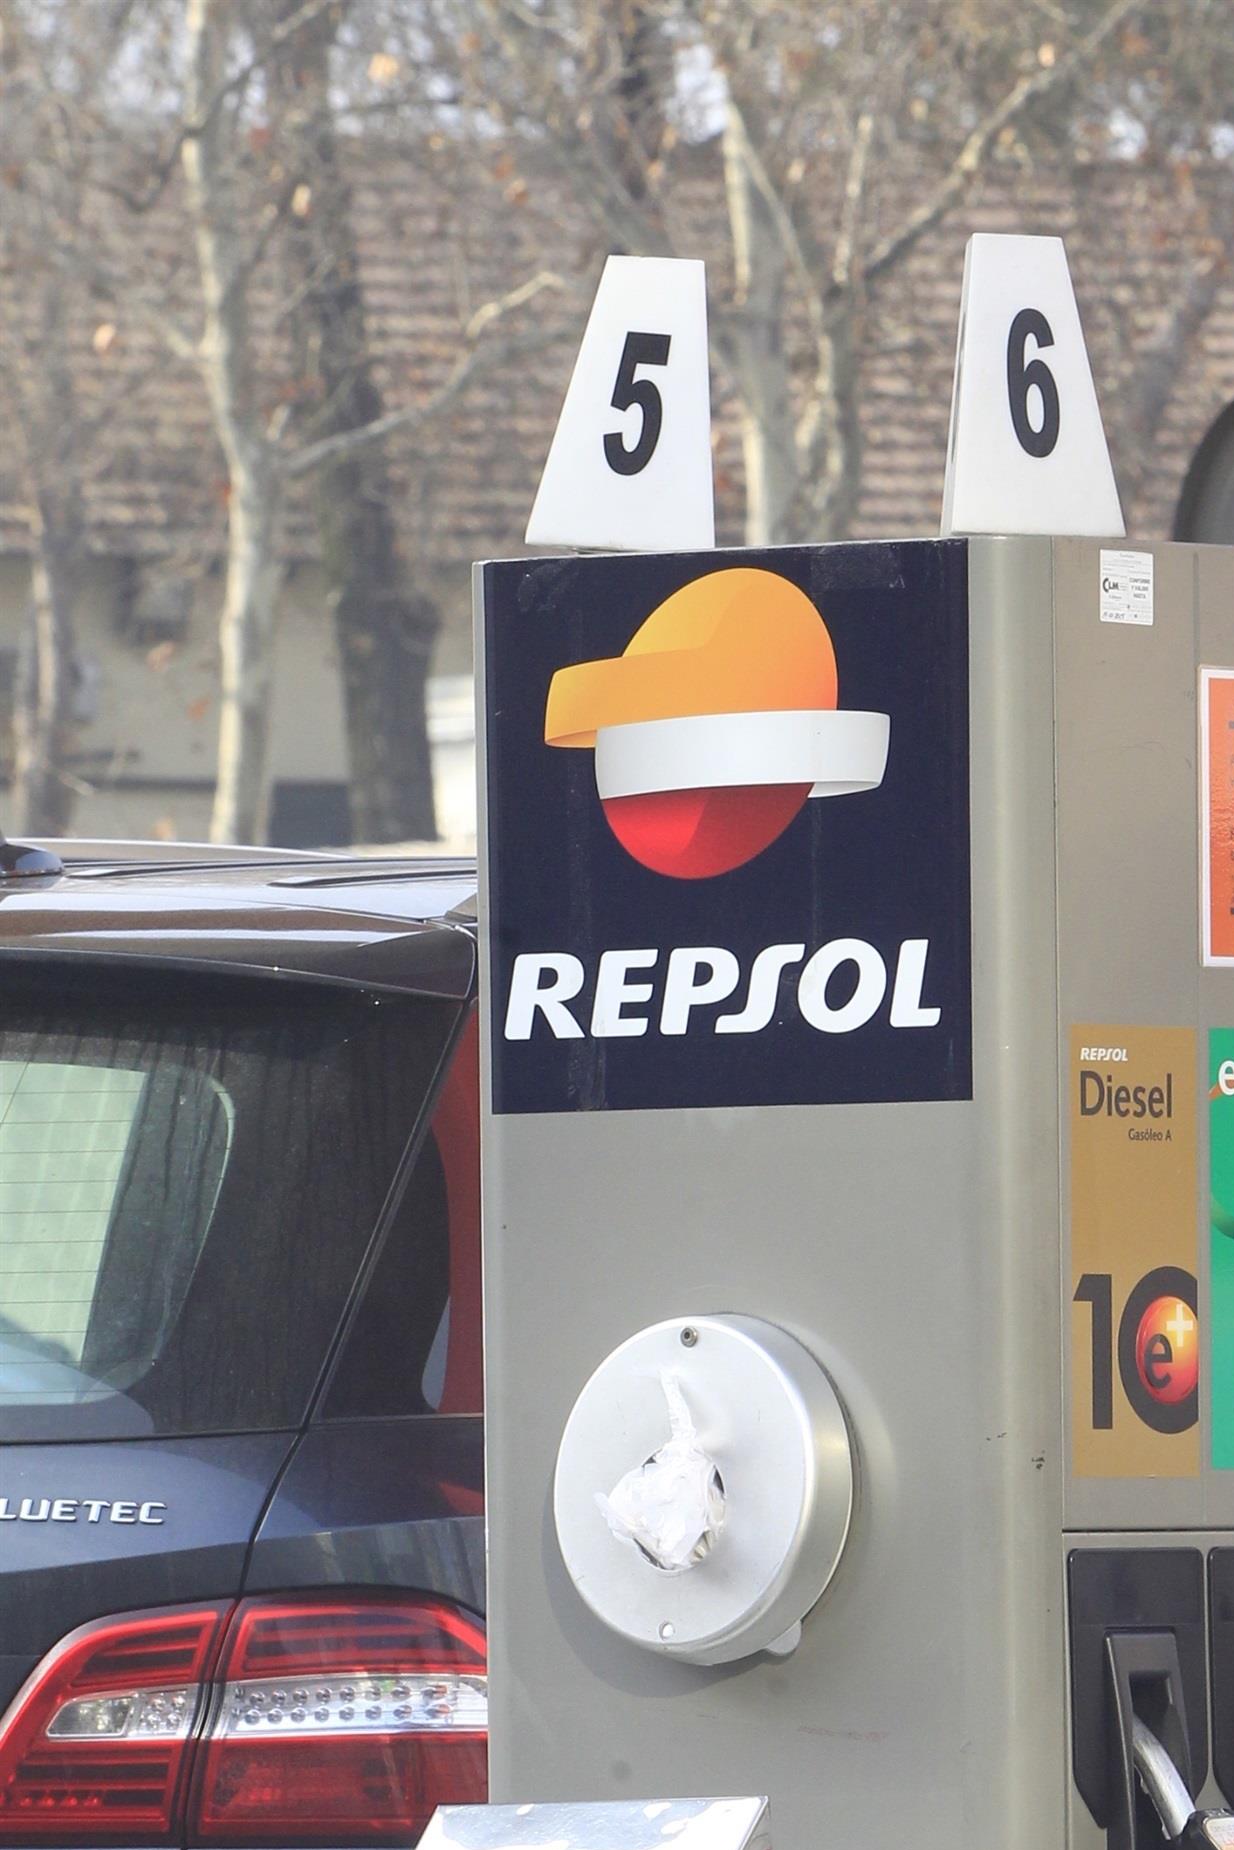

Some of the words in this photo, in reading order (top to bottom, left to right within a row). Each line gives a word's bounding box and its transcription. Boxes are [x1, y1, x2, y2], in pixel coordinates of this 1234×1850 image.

[602, 331, 672, 476] 5
[1006, 308, 1060, 458] 6
[504, 937, 942, 1041] REPSOL
[1080, 1047, 1129, 1062] REPSOL
[1079, 1070, 1174, 1119] Diesel
[1128, 1127, 1162, 1142] Gasóleo
[1164, 1130, 1173, 1142] A
